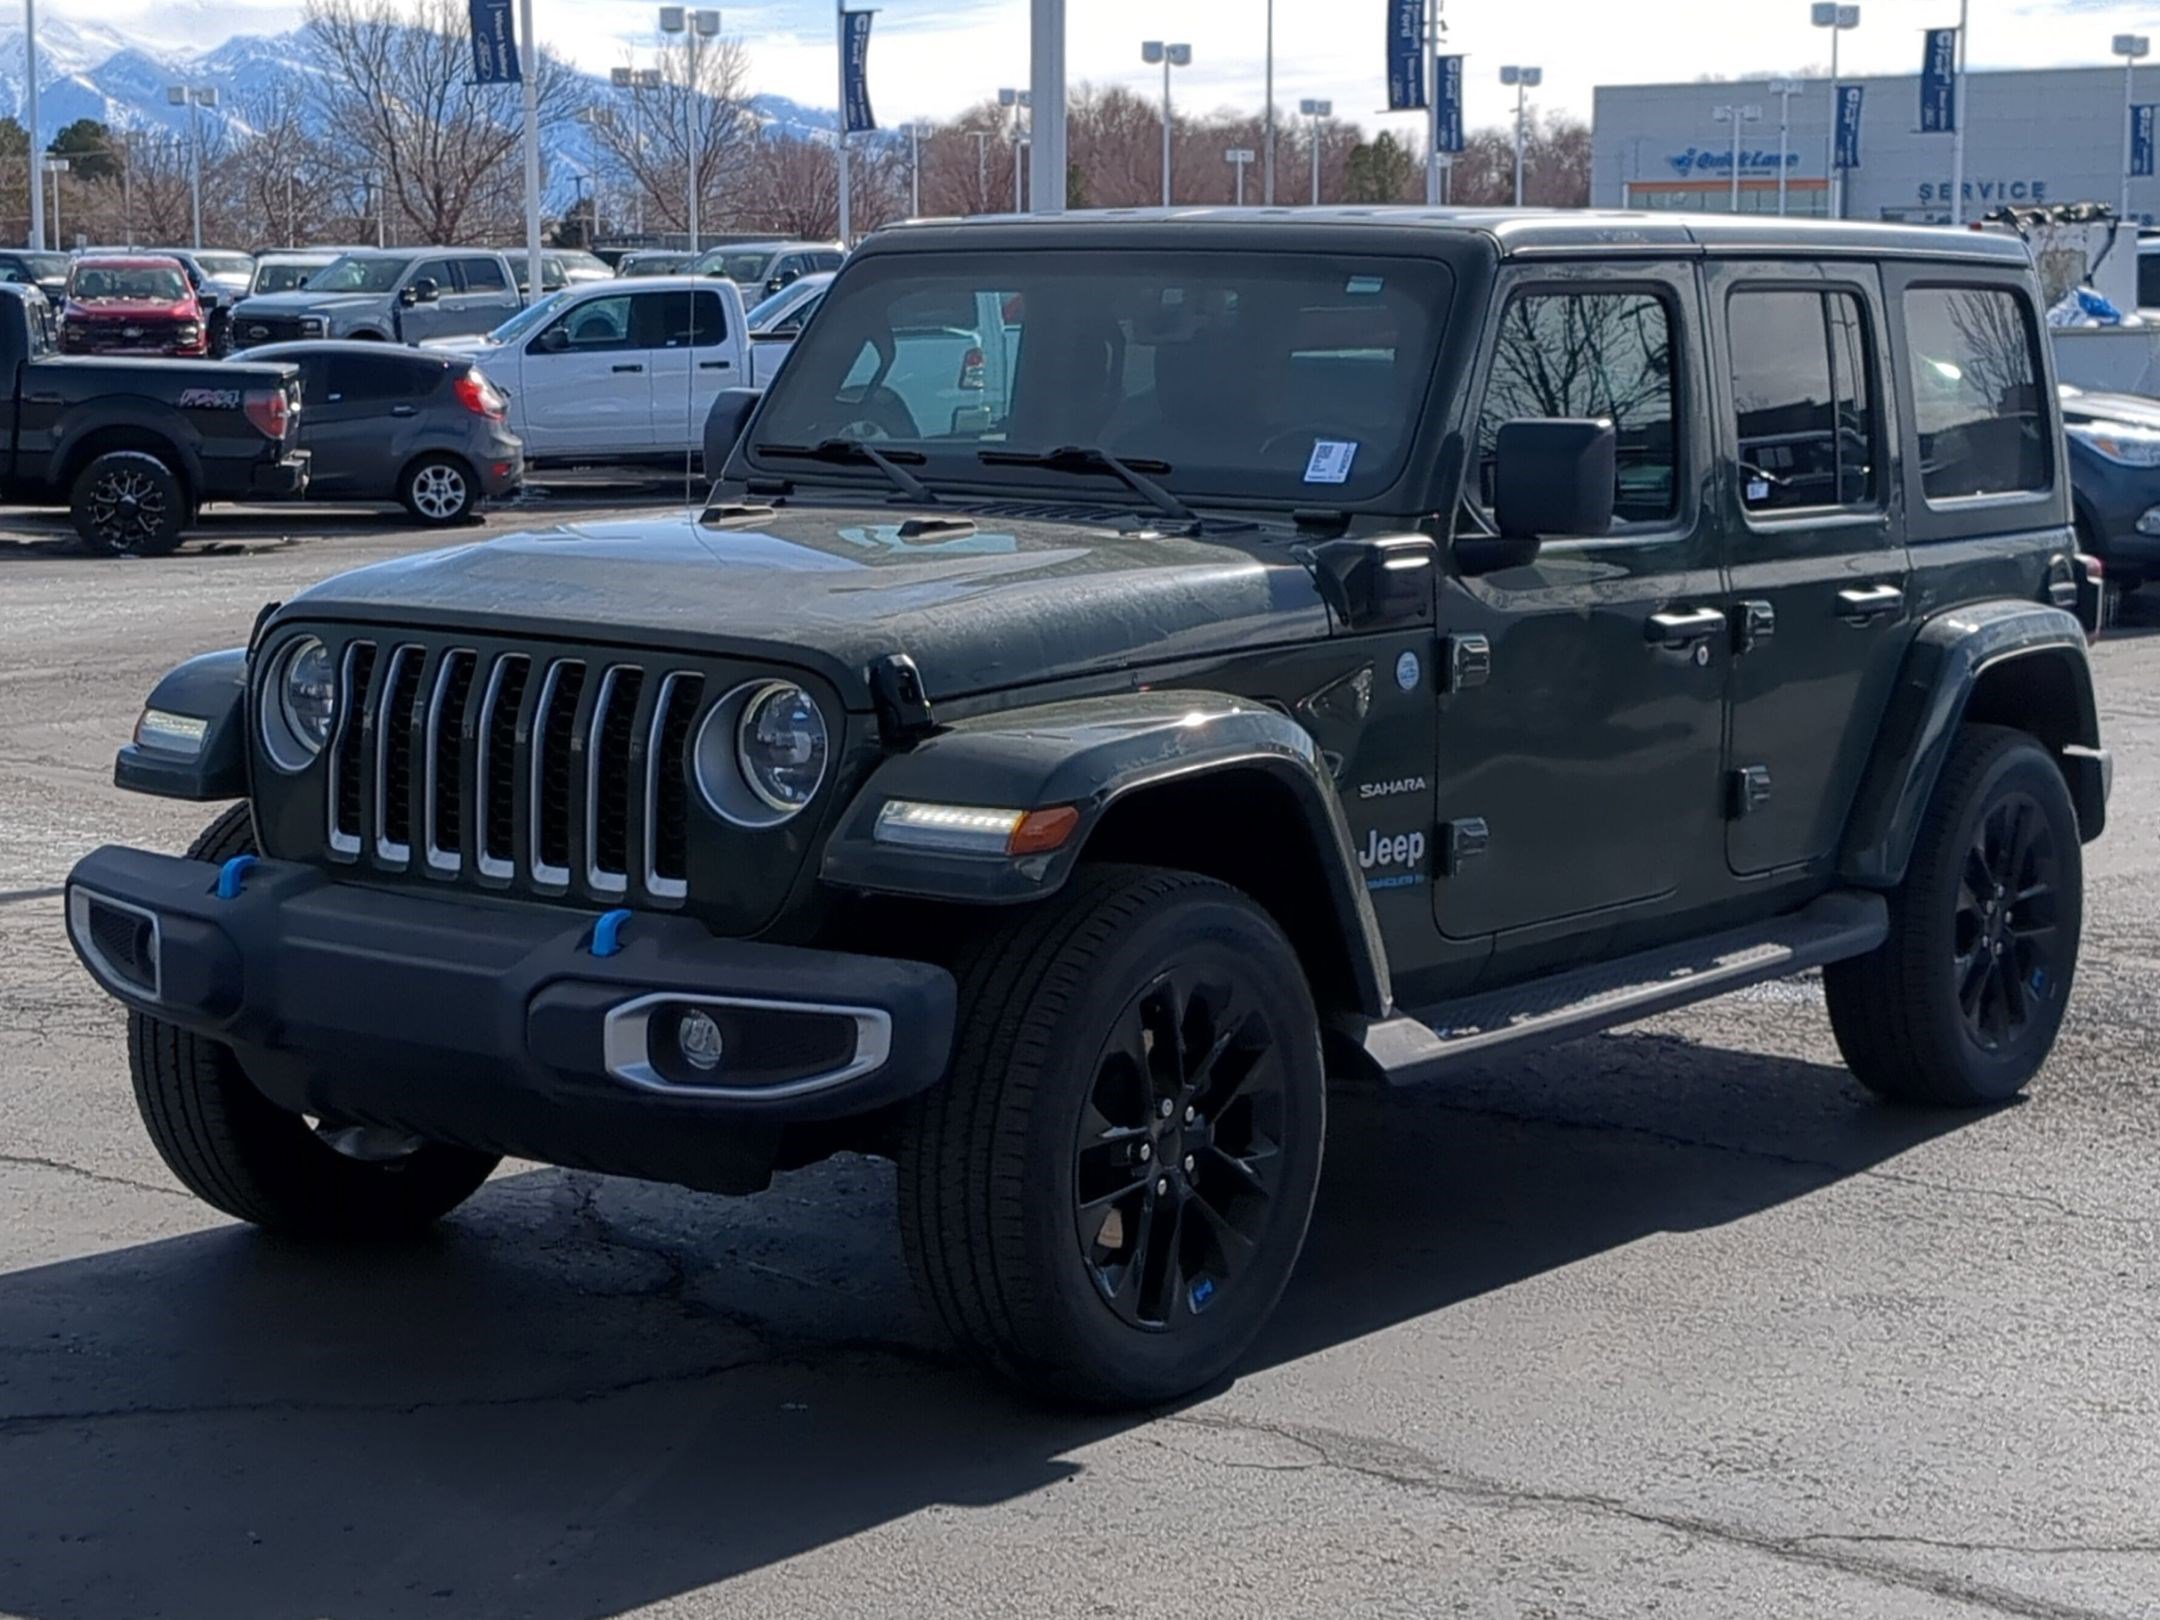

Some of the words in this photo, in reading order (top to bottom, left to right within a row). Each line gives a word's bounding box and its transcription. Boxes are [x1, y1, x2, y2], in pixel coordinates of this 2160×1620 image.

[495, 9, 505, 41] West
[1401, 4, 1413, 38] Ford
[498, 42, 509, 79] Valley
[852, 34, 862, 64] Ford
[1697, 151, 1751, 169] Quik
[1918, 181, 2047, 200] SERVICE
[1360, 777, 1426, 799] SAHARA
[1359, 829, 1425, 868] Jeep
